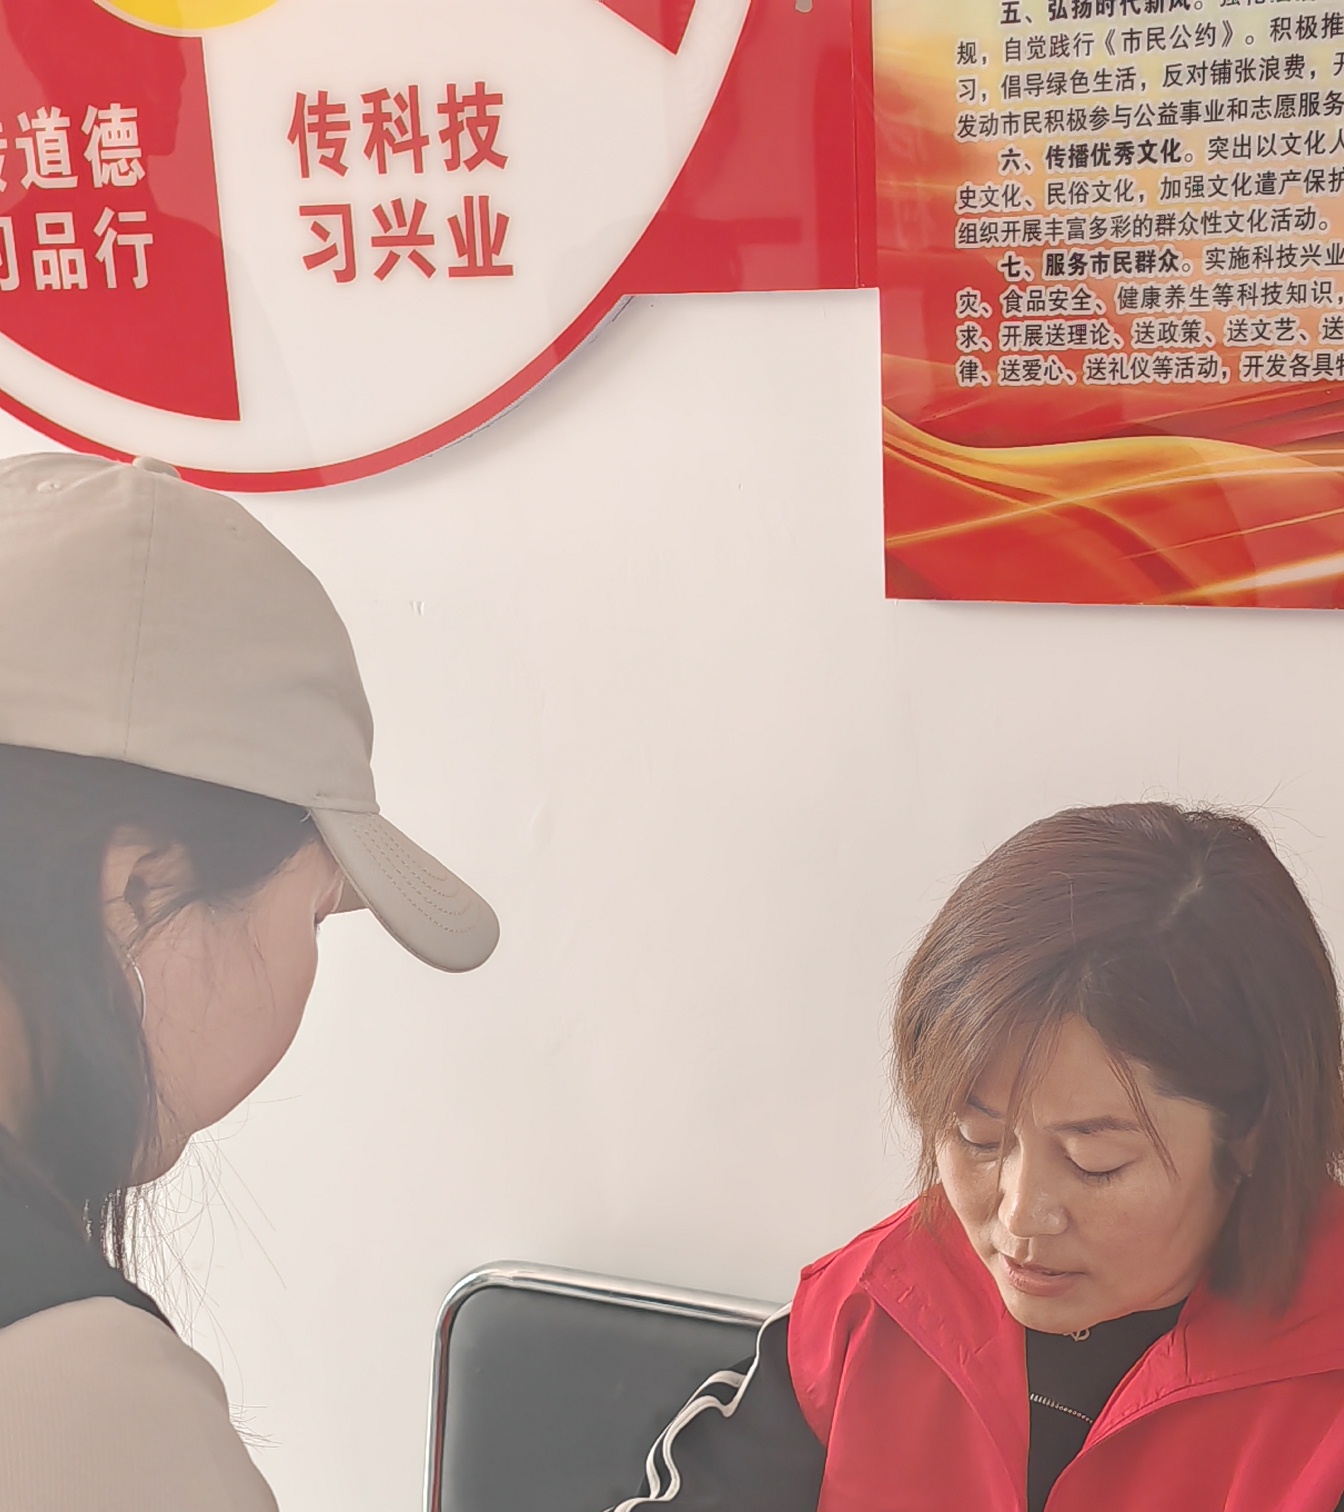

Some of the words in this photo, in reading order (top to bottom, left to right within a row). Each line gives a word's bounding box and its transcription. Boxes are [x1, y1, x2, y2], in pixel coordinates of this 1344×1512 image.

[286, 80, 510, 178] 传科技
[298, 192, 515, 283] 习兴业
[957, 206, 1329, 246] 组织开展丰富多彩的群众性文化活动。
